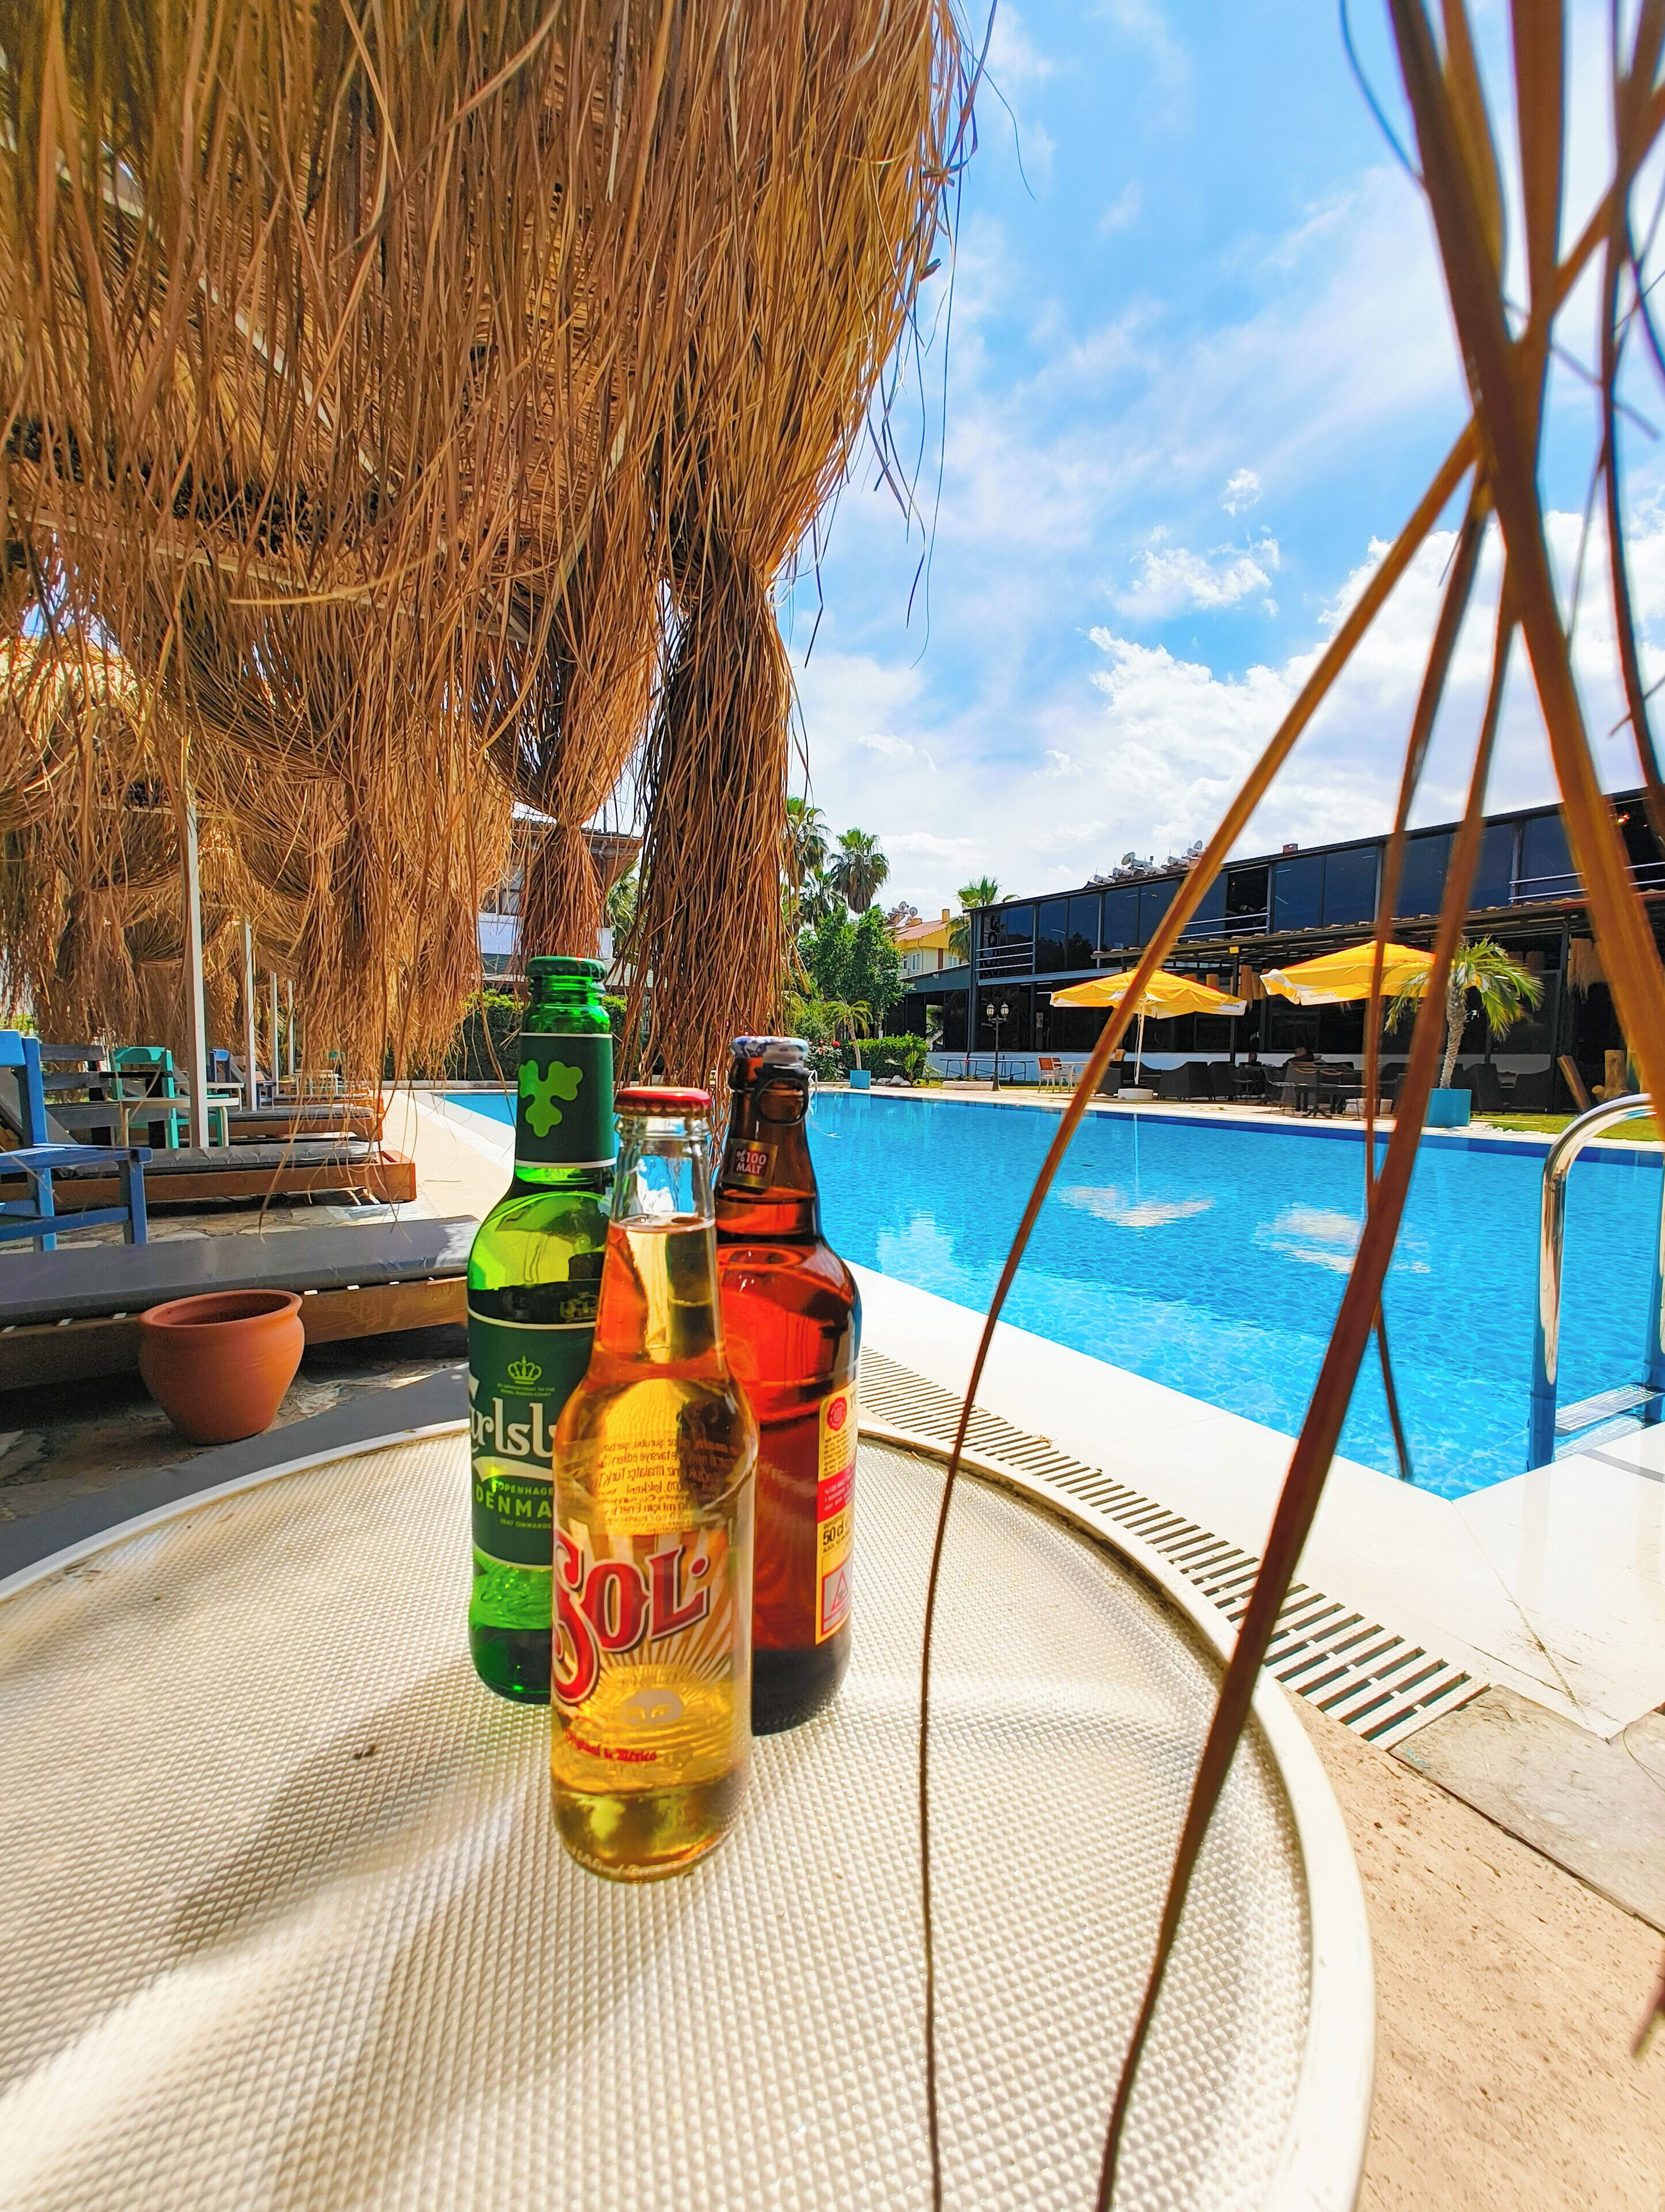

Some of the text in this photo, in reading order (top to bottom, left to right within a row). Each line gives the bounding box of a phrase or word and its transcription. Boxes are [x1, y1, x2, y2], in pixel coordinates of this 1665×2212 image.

[737, 1150, 767, 1165] %100
[737, 1162, 763, 1175] MALT
[476, 1483, 552, 1519] DENMA
